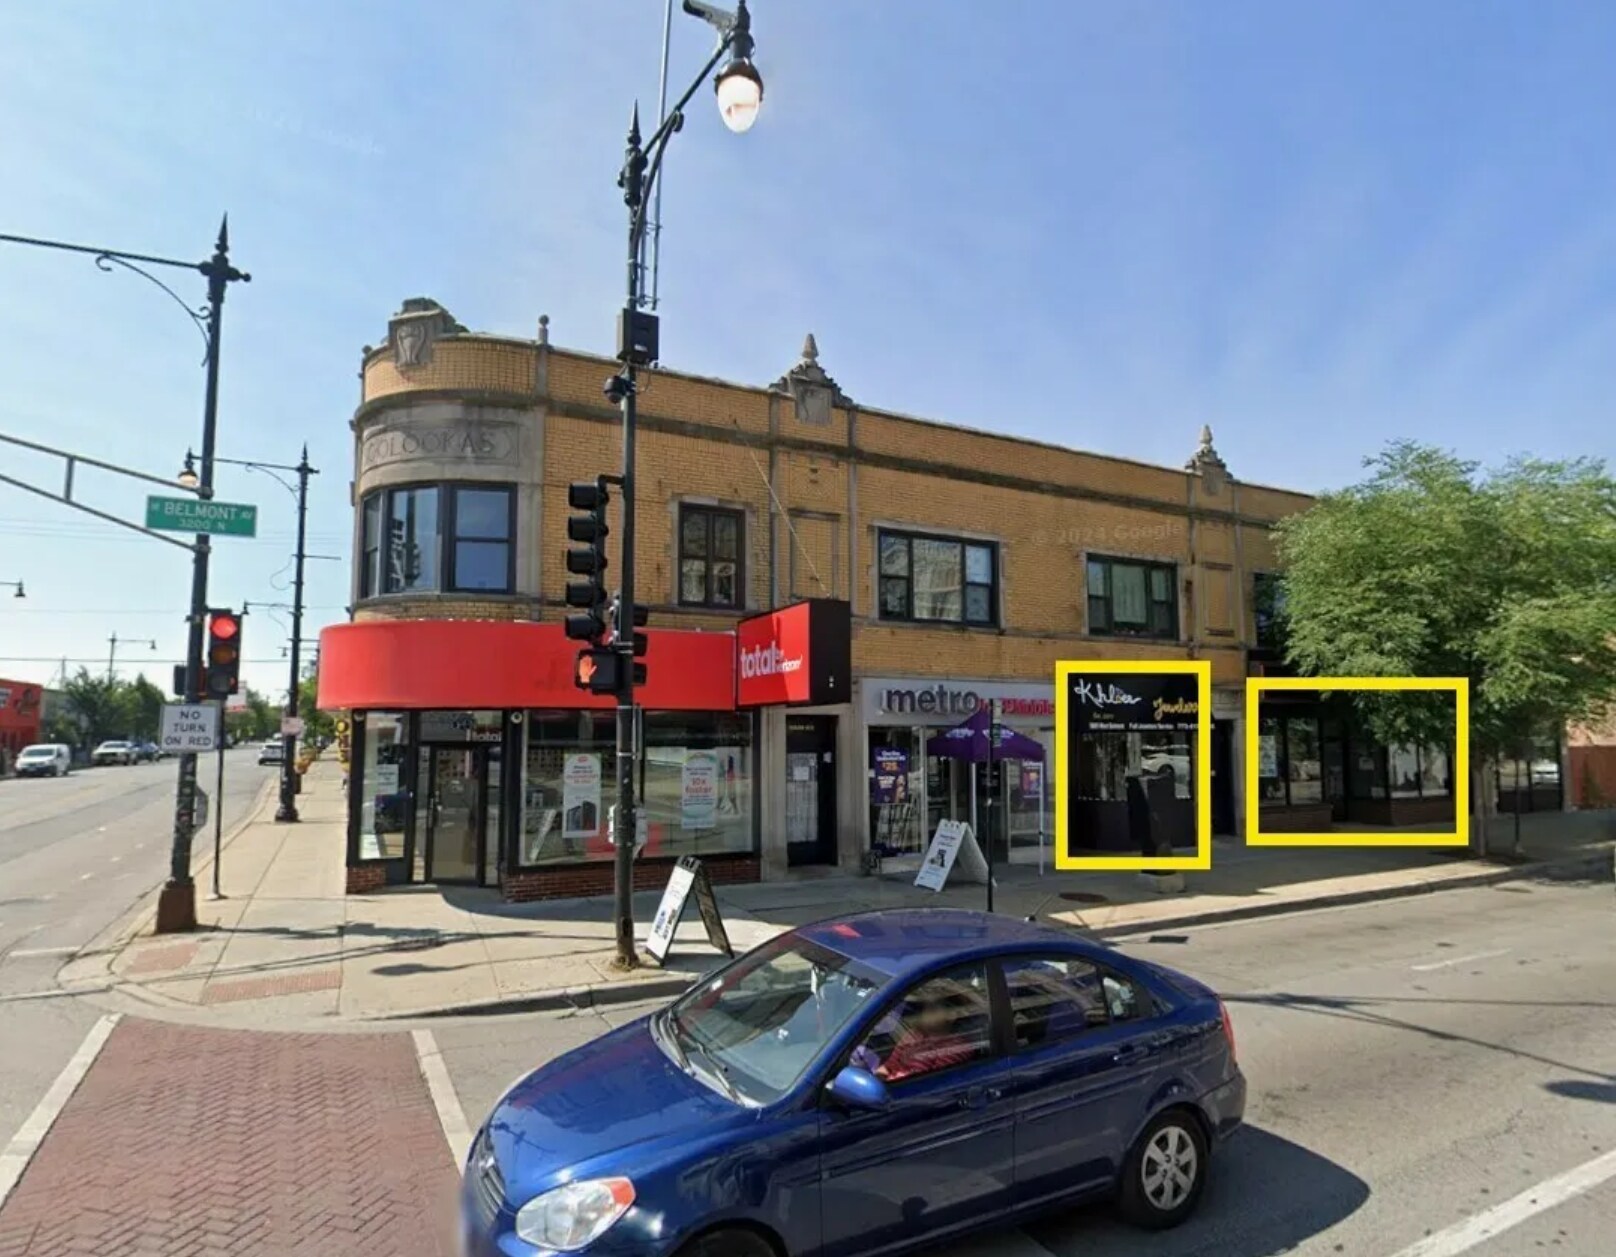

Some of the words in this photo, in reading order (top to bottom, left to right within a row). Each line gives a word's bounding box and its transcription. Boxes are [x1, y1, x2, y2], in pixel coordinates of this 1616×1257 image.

[164, 501, 239, 520] BELMONT
[179, 517, 211, 530] 3200
[218, 522, 226, 531] N
[740, 640, 776, 679] total
[884, 684, 980, 713] metro
[180, 710, 201, 720] NO
[173, 723, 206, 732] TURN
[165, 736, 181, 746] ON
[188, 736, 212, 746] RED
